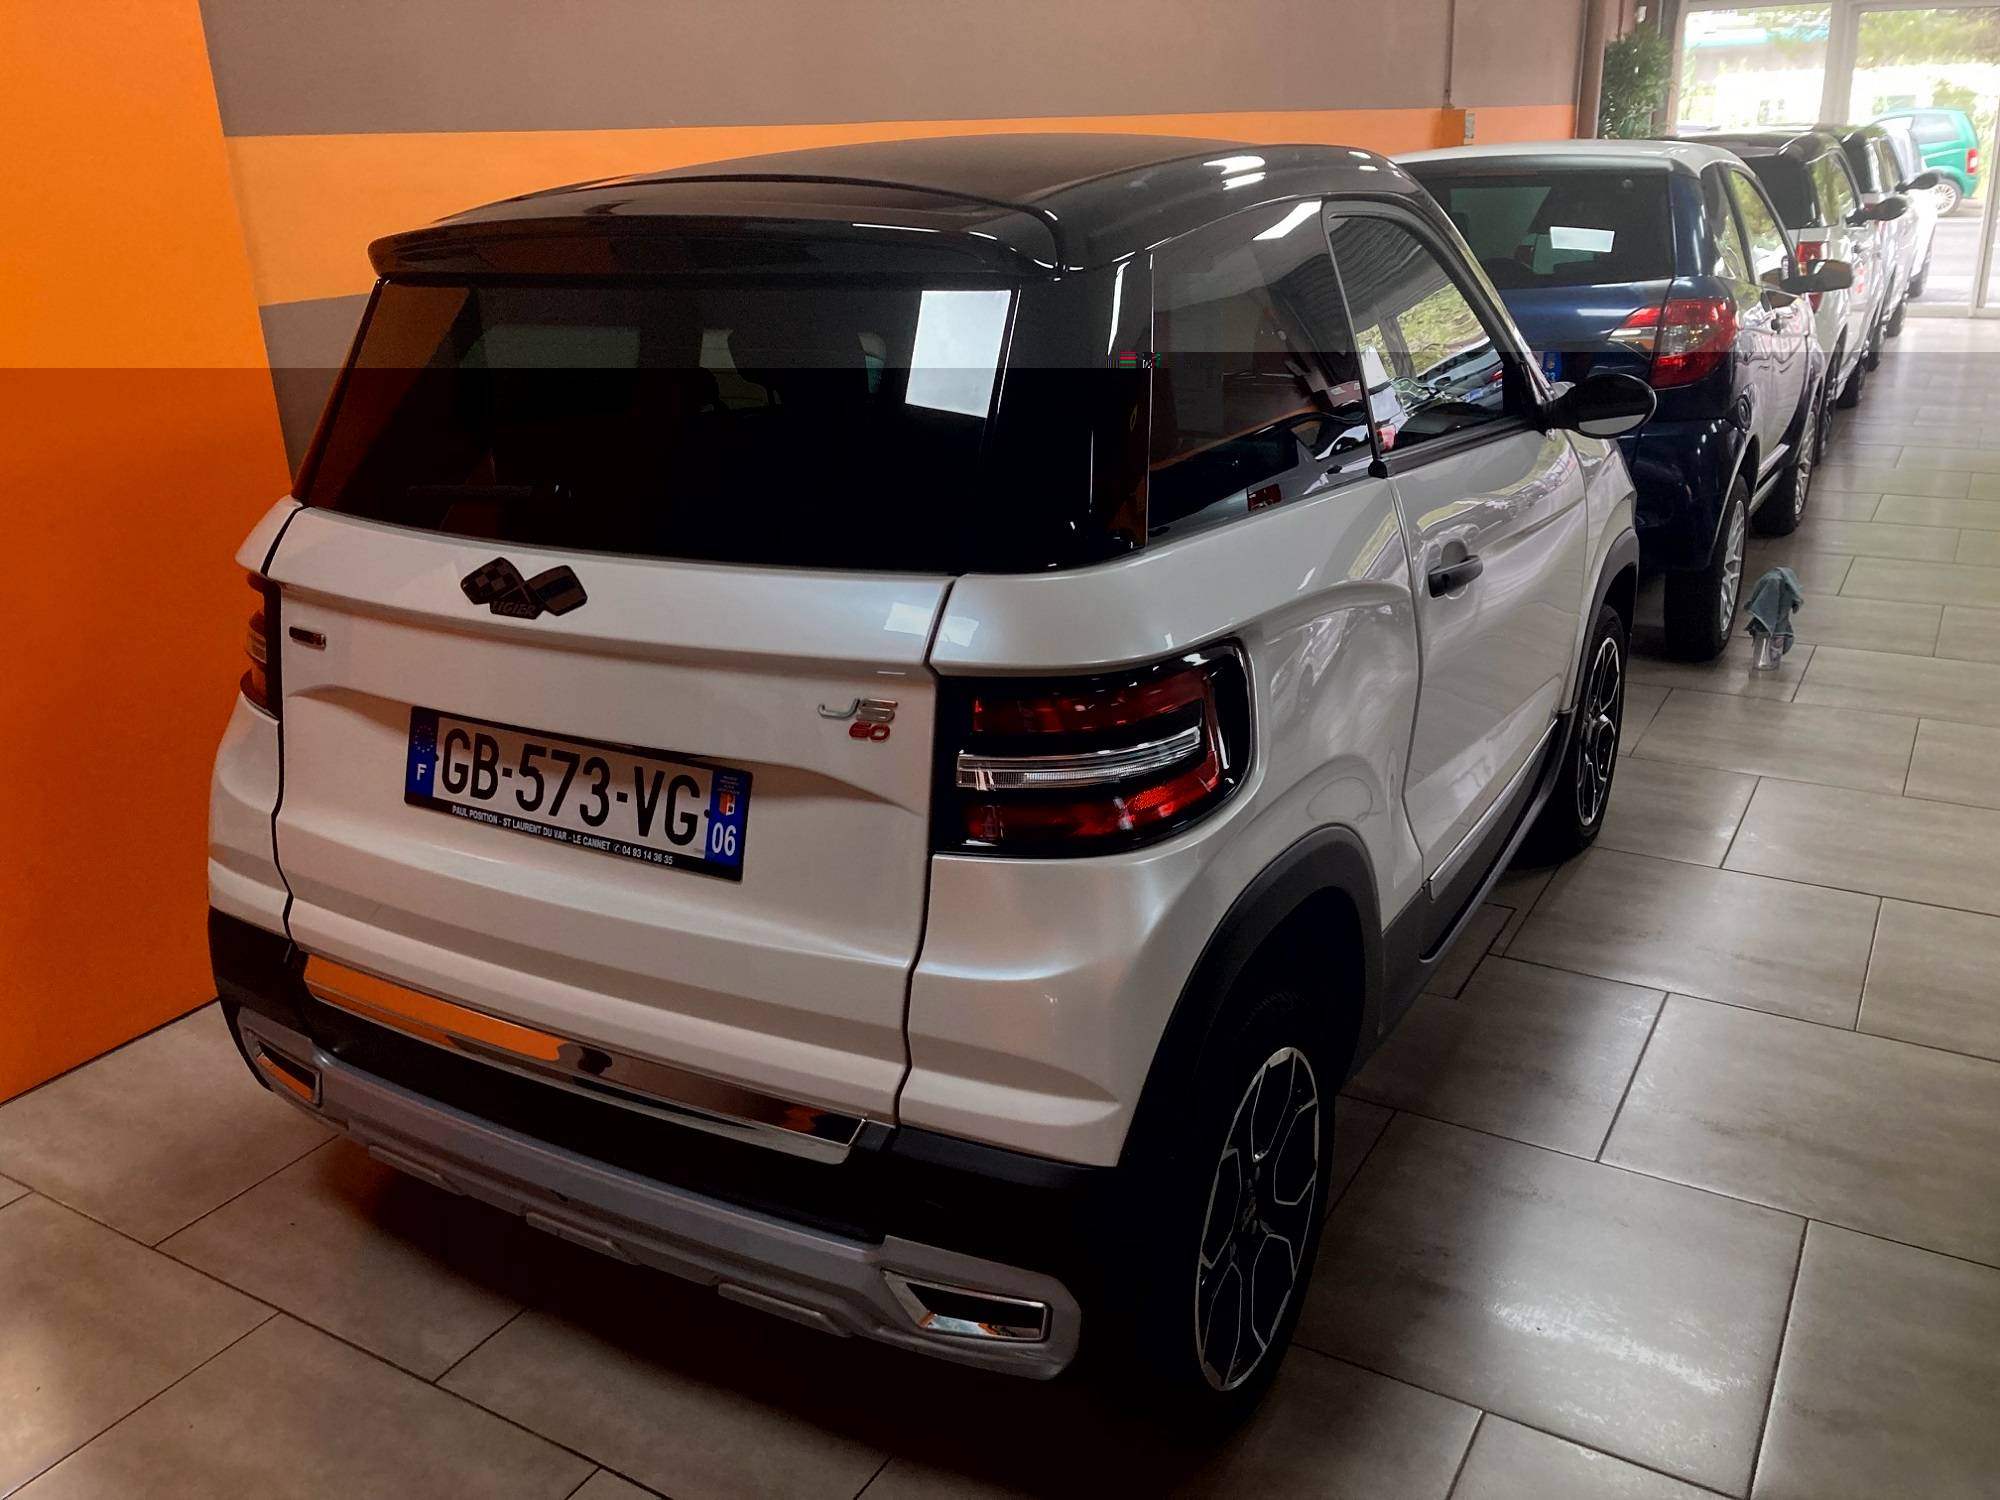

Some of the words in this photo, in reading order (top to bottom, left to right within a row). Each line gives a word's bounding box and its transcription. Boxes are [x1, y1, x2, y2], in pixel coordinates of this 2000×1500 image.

[849, 721, 890, 741] 60
[416, 763, 427, 781] F
[441, 728, 701, 847] GB-573-VG
[452, 804, 468, 817] PAUL
[469, 809, 498, 825] POSITION
[503, 817, 512, 827] ST
[512, 819, 542, 835] LAURENT
[543, 826, 553, 837] DU
[553, 828, 568, 841] VAR
[572, 834, 582, 845] LE
[582, 836, 611, 852] CANNET
[622, 845, 631, 856] 04
[632, 847, 642, 858] 93
[643, 850, 652, 860] 14
[663, 854, 674, 865] 35
[711, 821, 737, 857] 06
